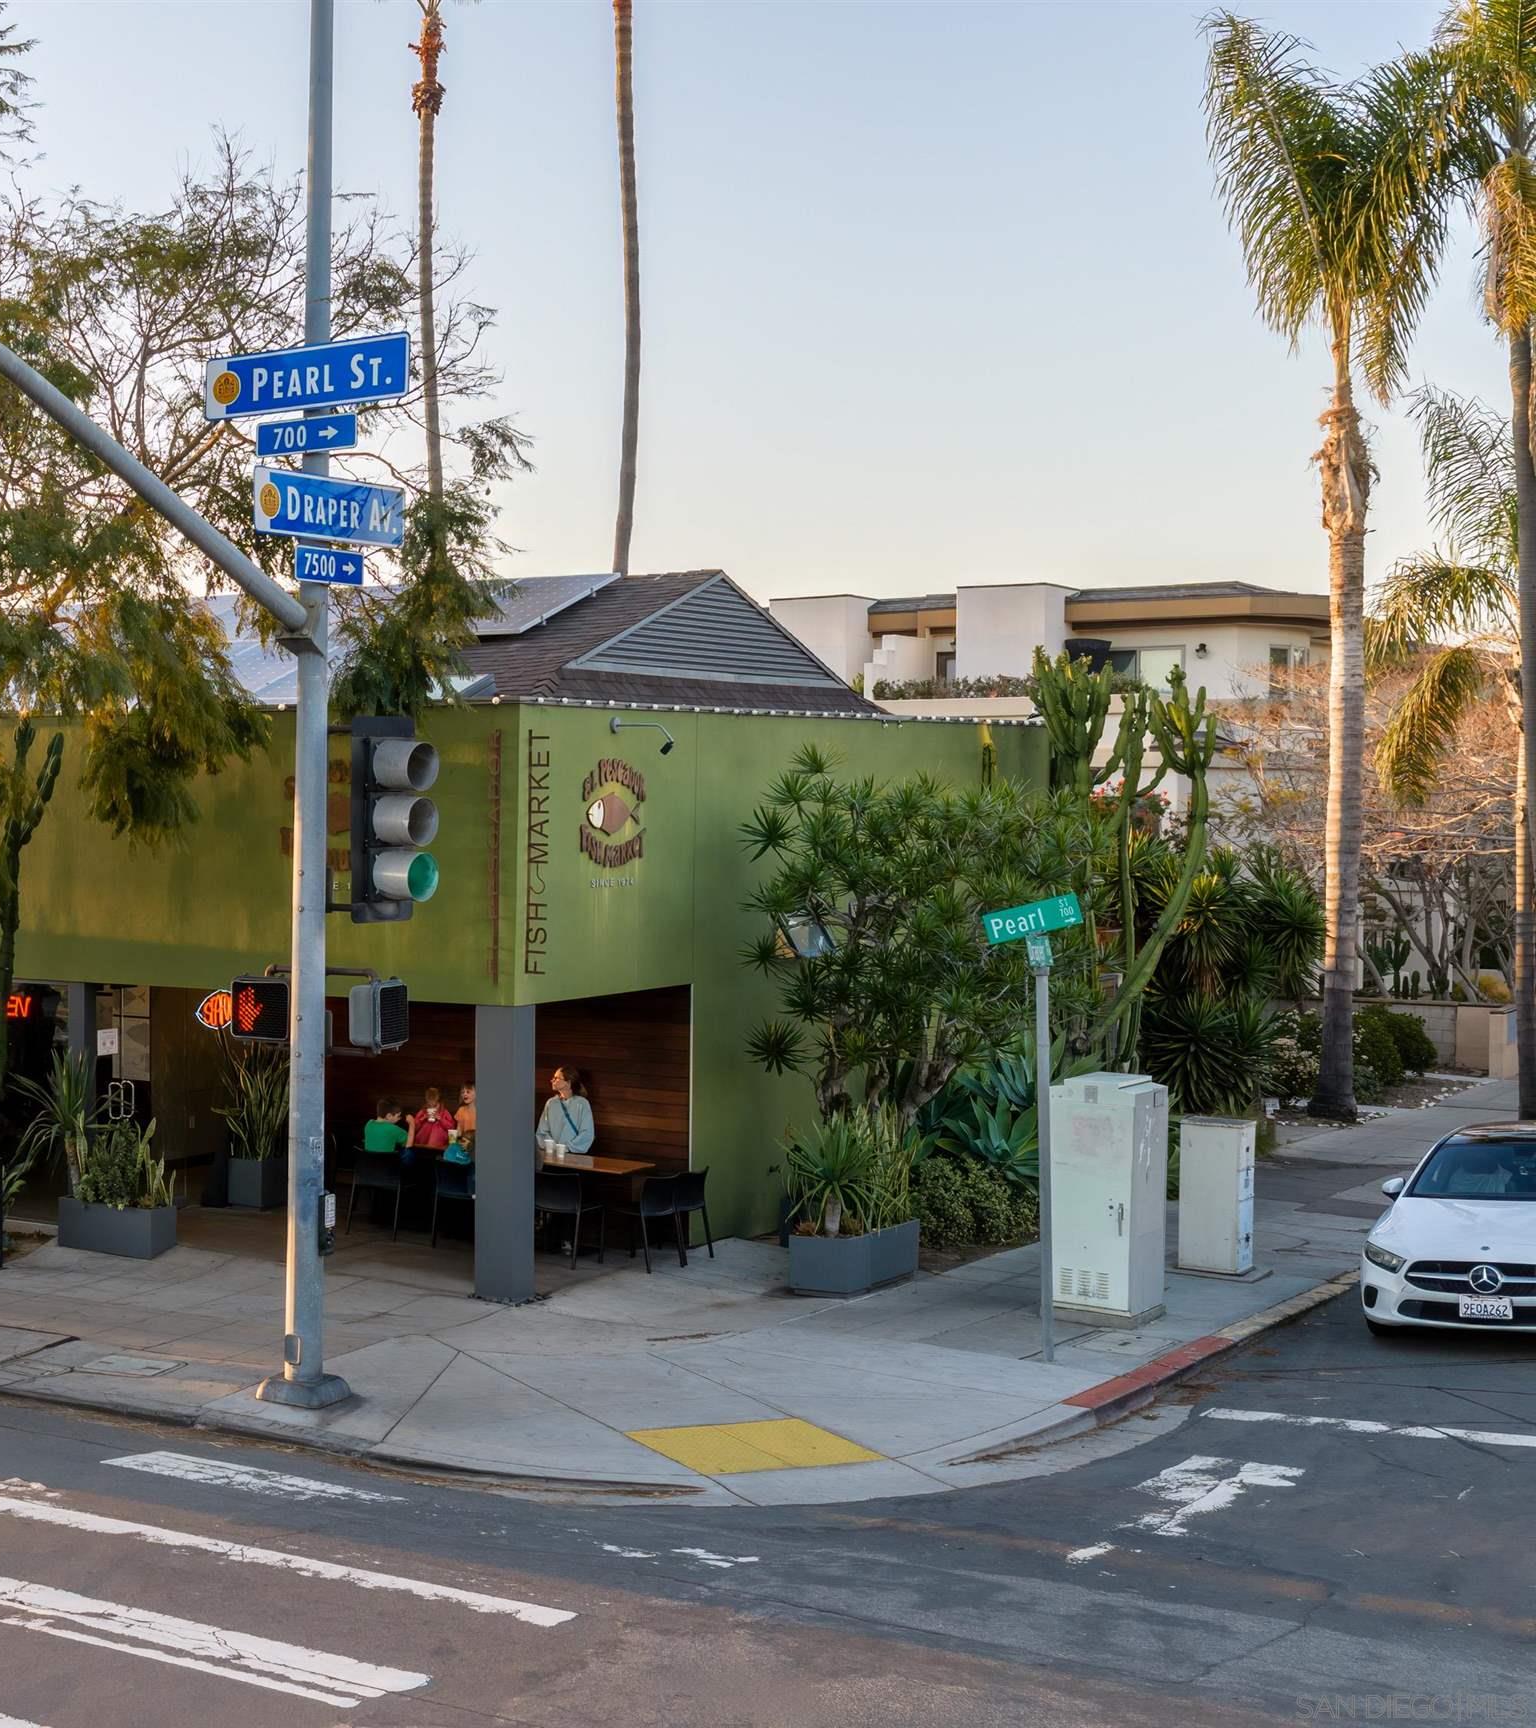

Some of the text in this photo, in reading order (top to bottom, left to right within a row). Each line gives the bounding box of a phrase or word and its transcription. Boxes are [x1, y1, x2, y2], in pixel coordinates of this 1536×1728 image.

[252, 353, 393, 402] PEARL ST.
[273, 425, 307, 449] 700
[287, 485, 360, 530] DRAPER
[303, 553, 336, 578] 7500
[526, 730, 551, 975] FISH MARKET
[591, 878, 615, 889] SINCE
[990, 908, 1045, 939] Pearl
